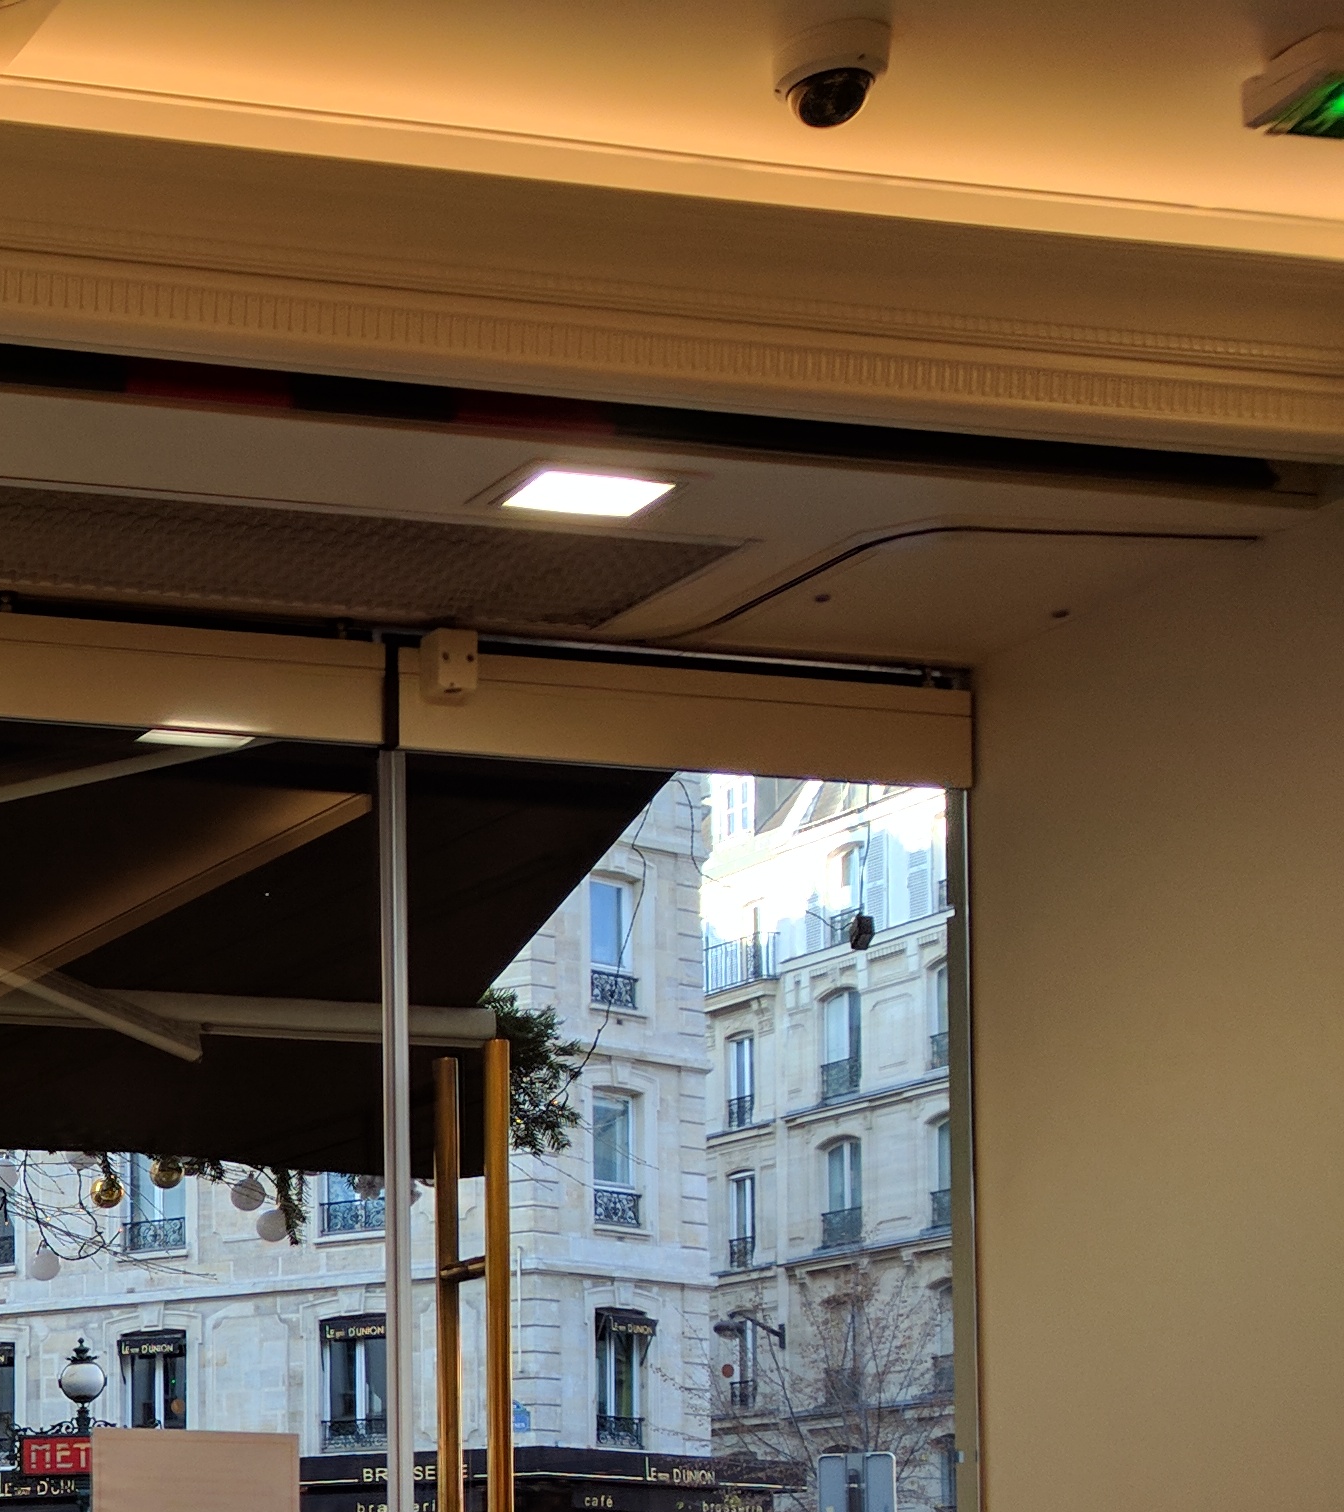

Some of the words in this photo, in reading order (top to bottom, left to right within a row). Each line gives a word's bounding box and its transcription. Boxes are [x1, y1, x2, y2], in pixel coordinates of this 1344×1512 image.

[30, 1443, 91, 1469] MET
[362, 1464, 468, 1482] BRSEE
[584, 1494, 614, 1508] café
